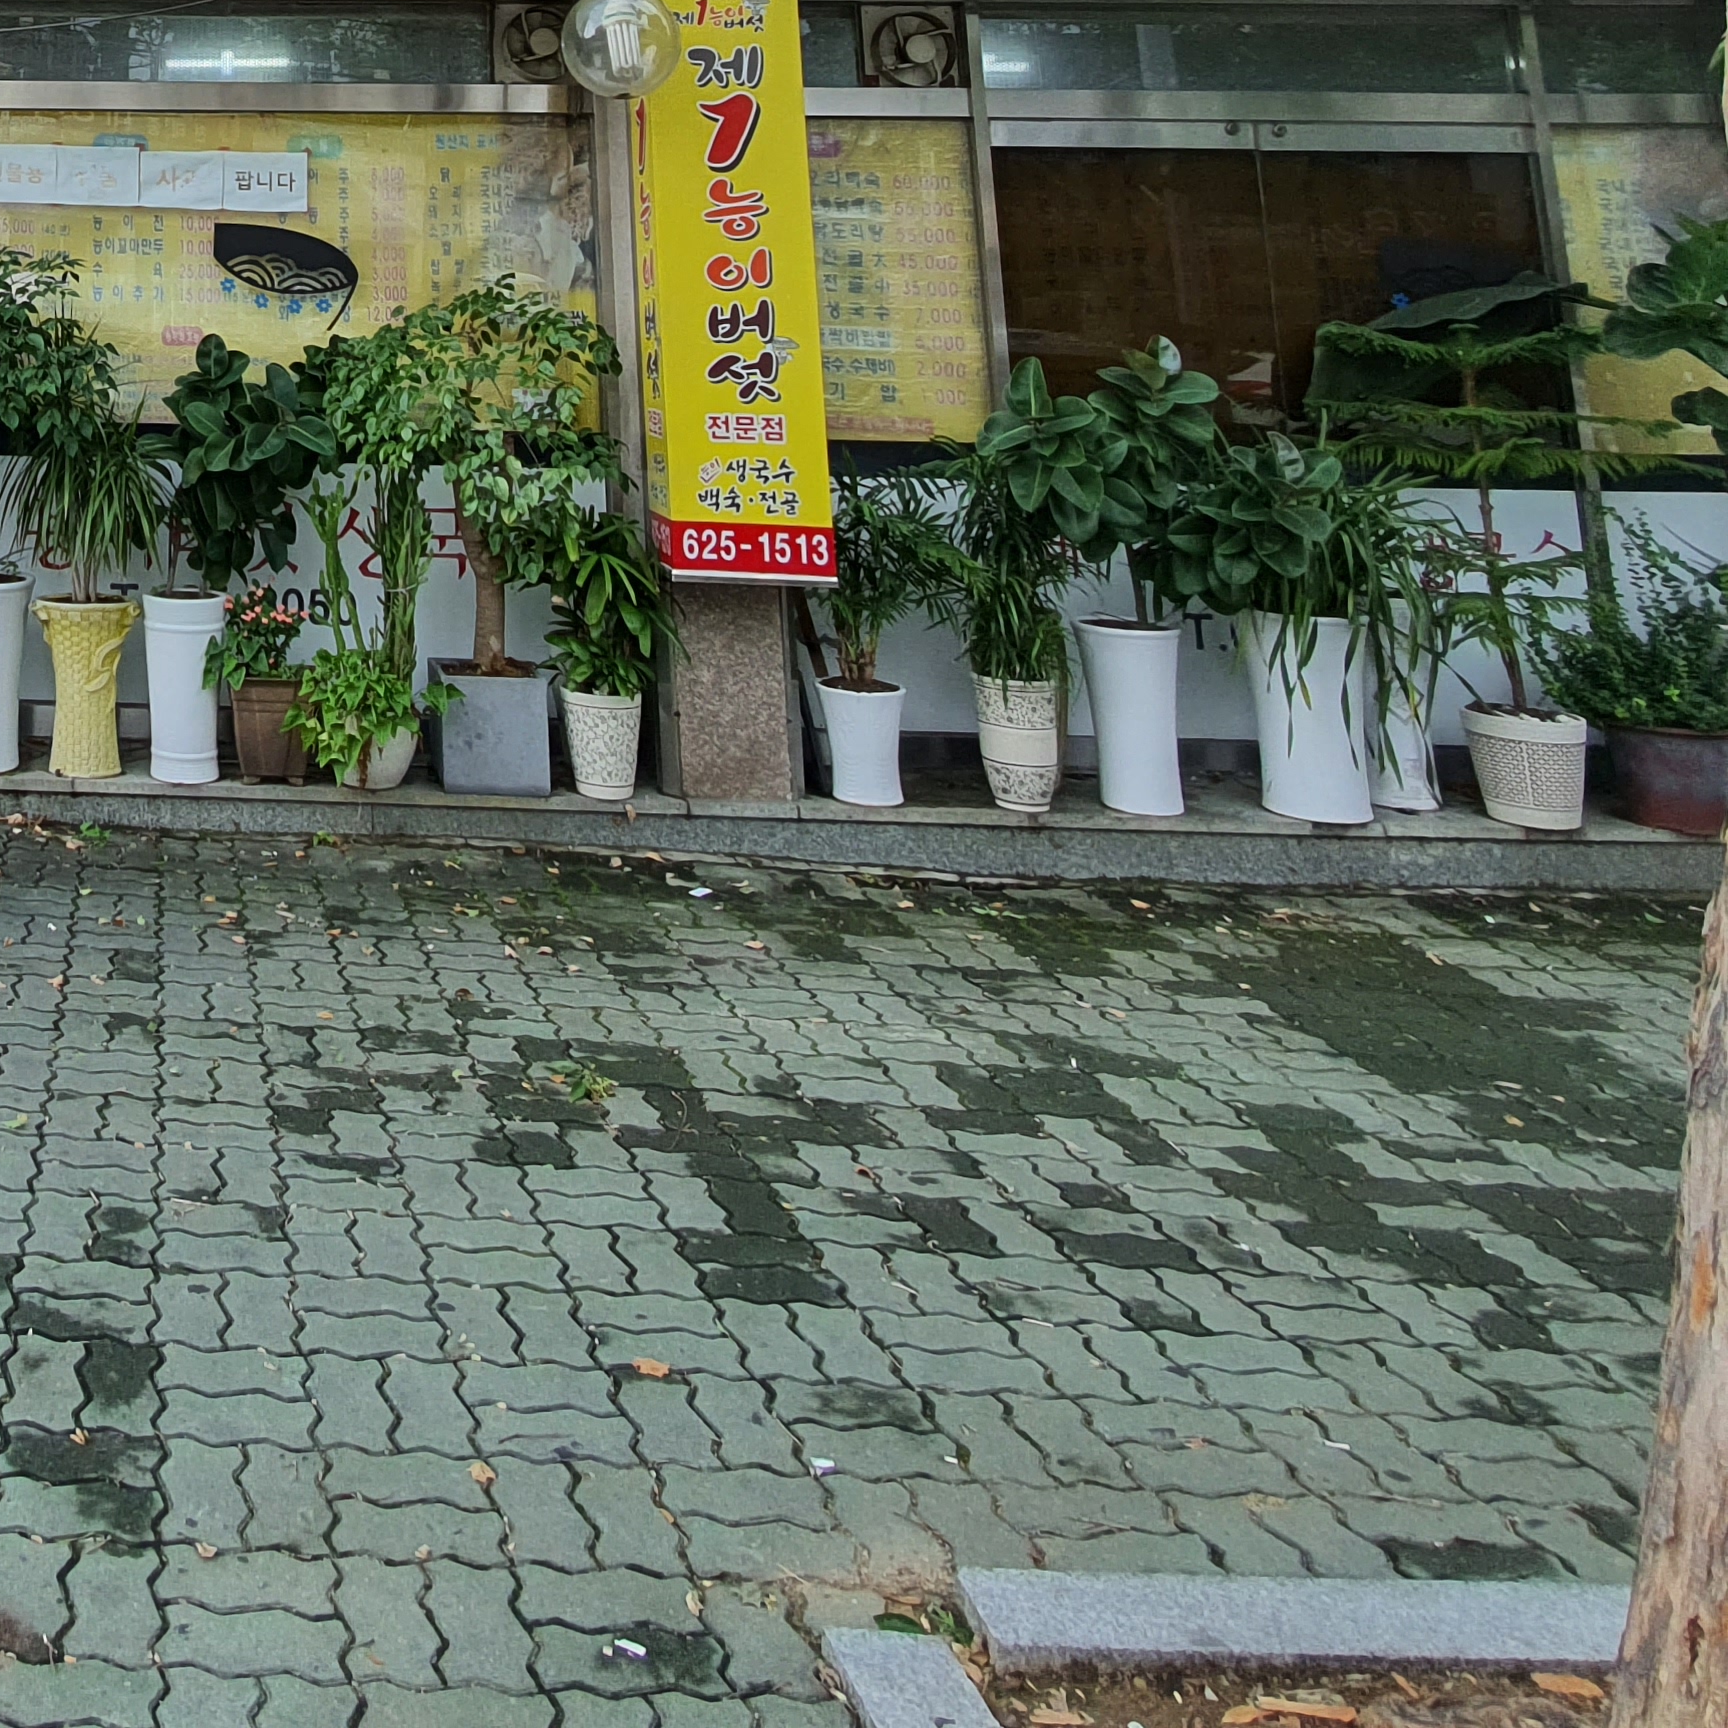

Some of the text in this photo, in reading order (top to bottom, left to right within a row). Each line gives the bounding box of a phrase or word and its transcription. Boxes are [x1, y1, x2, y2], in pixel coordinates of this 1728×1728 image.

[235, 170, 296, 192] 팝니다
[687, 44, 783, 403] 제1능이버섯
[179, 240, 213, 256] 10,00
[373, 286, 408, 303] 3,000
[367, 306, 408, 323] 12,0
[707, 414, 785, 442] 전문점
[725, 458, 796, 485] 생국수
[682, 528, 829, 566] 625-1513
